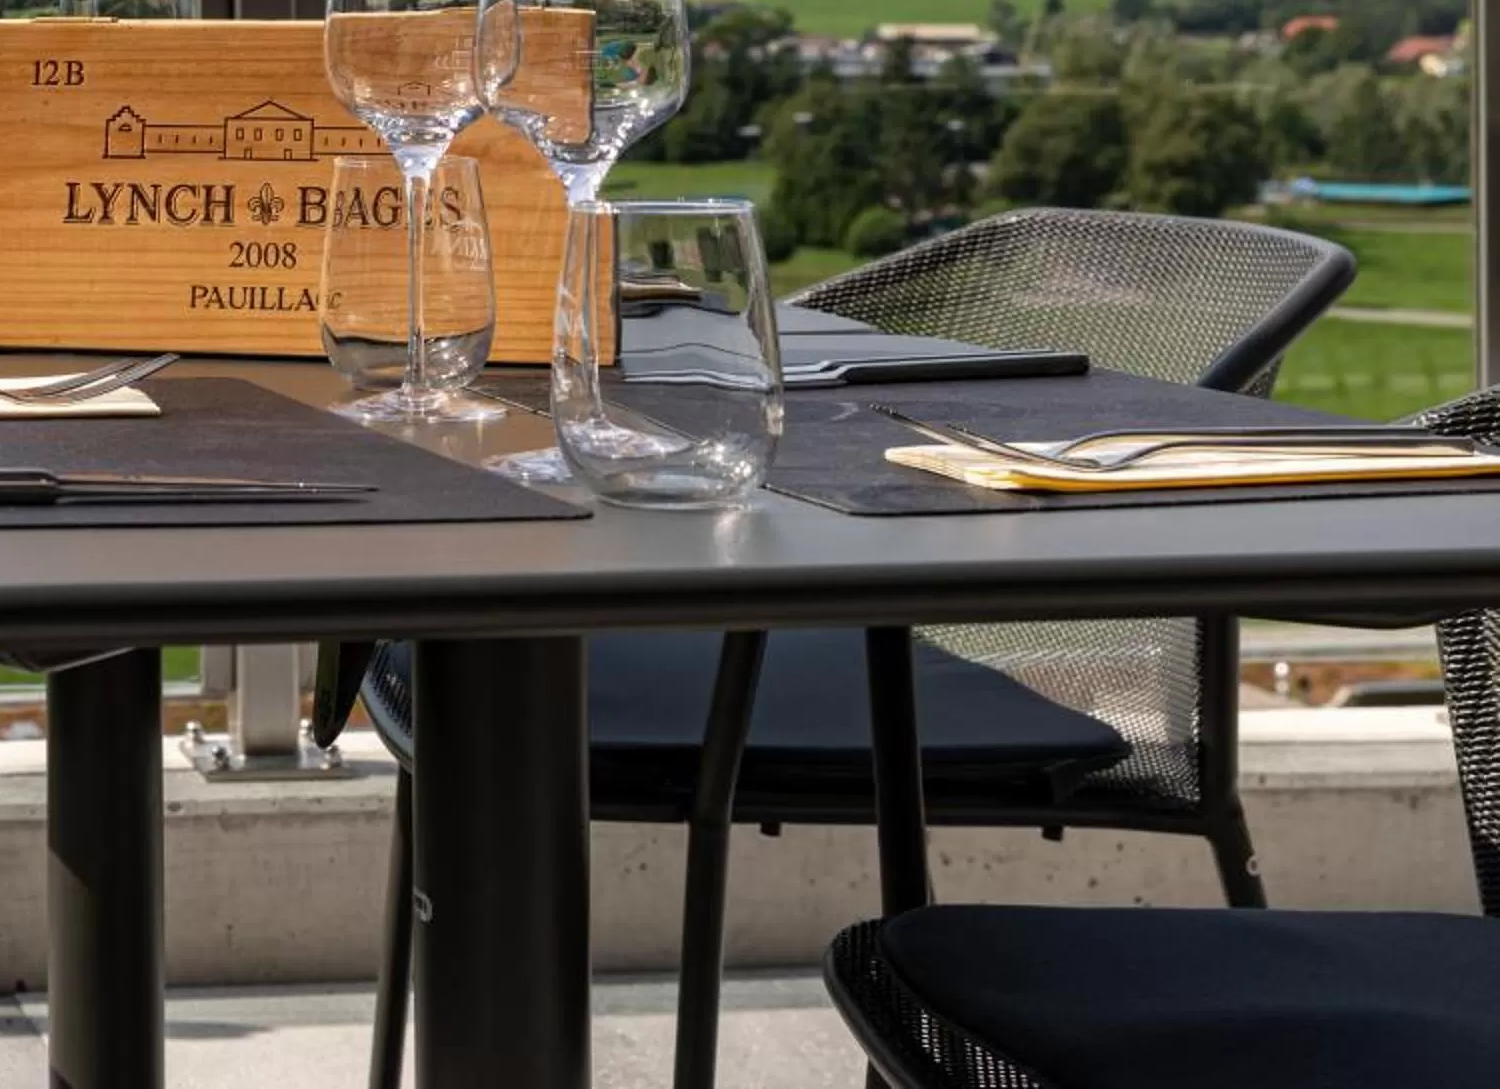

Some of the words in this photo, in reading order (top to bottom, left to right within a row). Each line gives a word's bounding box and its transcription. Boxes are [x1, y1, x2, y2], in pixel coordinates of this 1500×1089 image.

[62, 181, 237, 227] LYNCH
[296, 185, 462, 232] BAGS
[228, 241, 298, 269] 2008
